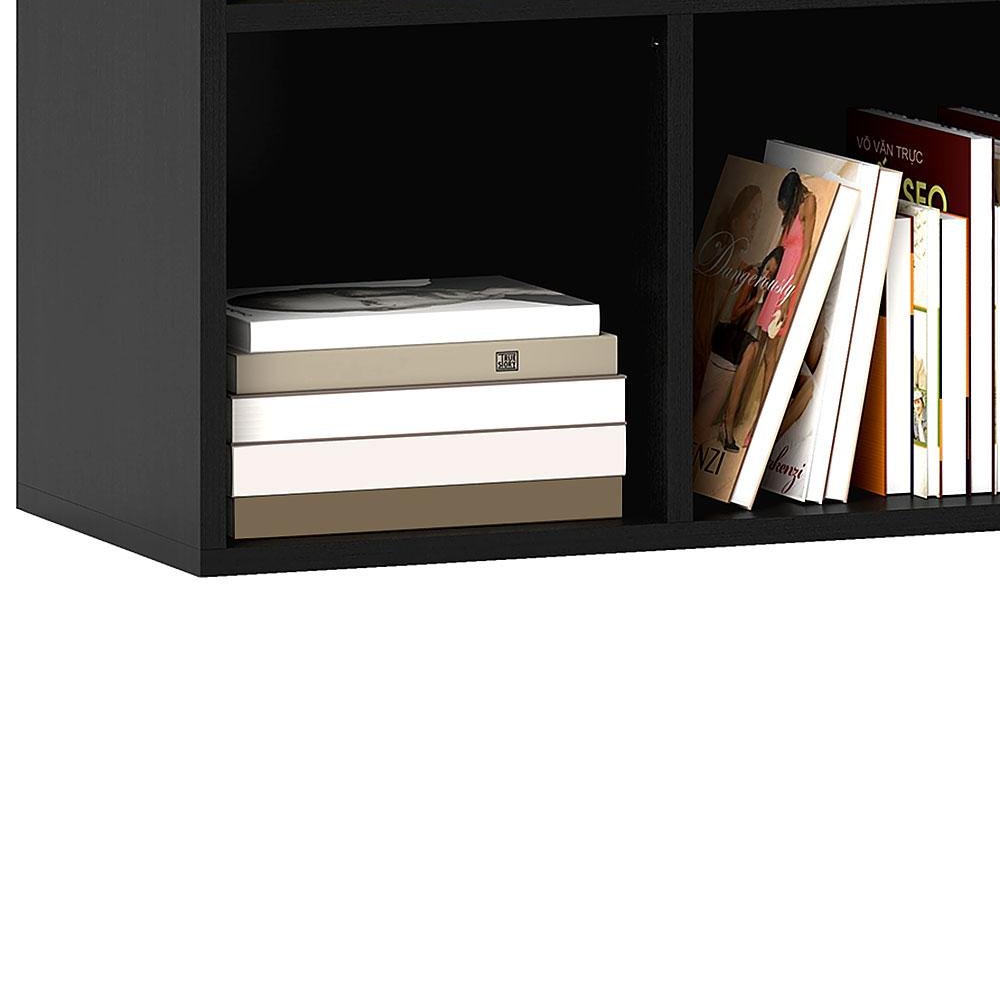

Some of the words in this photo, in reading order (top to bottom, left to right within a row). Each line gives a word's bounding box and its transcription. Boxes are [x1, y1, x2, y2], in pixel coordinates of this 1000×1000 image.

[873, 139, 894, 157] VĂN
[896, 145, 924, 165] TRỰC
[691, 231, 796, 308] Dangerously
